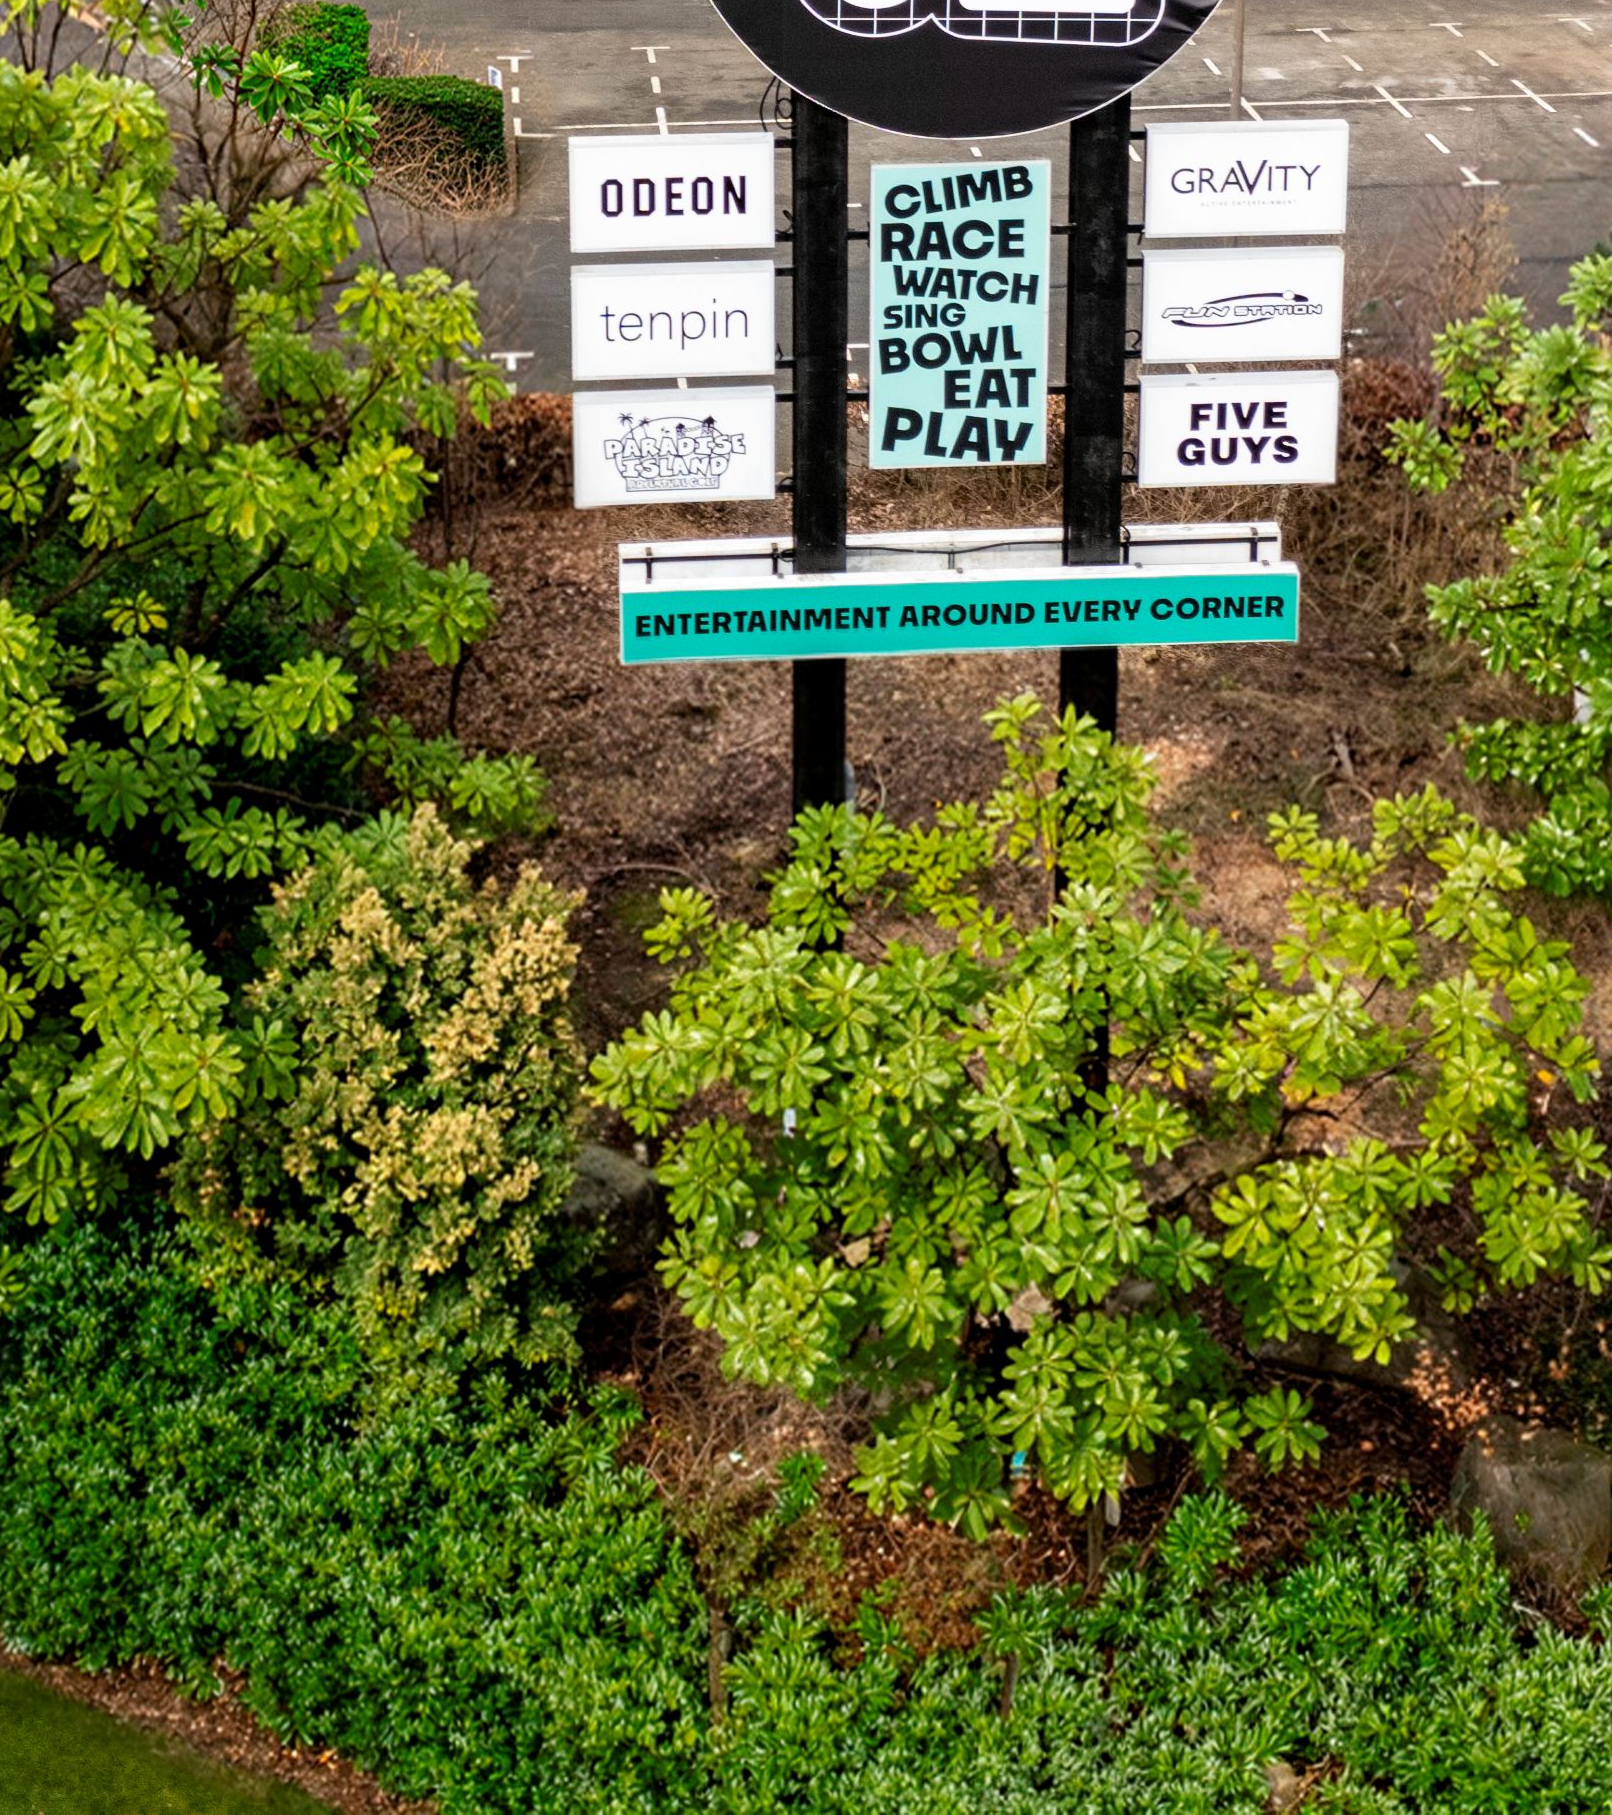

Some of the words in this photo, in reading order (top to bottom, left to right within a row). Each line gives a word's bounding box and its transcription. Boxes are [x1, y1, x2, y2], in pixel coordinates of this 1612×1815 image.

[600, 175, 746, 218] ODEON
[884, 165, 1034, 219] CLIMB
[1170, 159, 1321, 196] GRAVITY
[880, 218, 1025, 263] RACE
[892, 264, 1040, 306] WATCH
[599, 298, 748, 351] tenpin
[883, 302, 966, 330] SING
[1161, 305, 1230, 319] FUN
[1233, 303, 1323, 317] STATION
[878, 324, 1023, 375] BOWL
[944, 367, 1037, 410] EAT
[881, 406, 1034, 463] PLAY
[1190, 401, 1288, 431] FIVE
[603, 433, 747, 459] PARADISE
[621, 455, 729, 479] ISLAND
[1177, 435, 1299, 467] GUYS
[635, 607, 891, 638] ENTERTAINMENT
[899, 602, 1036, 627] AROUND
[1044, 599, 1142, 624] EVERY
[1149, 595, 1285, 621] CORNER
